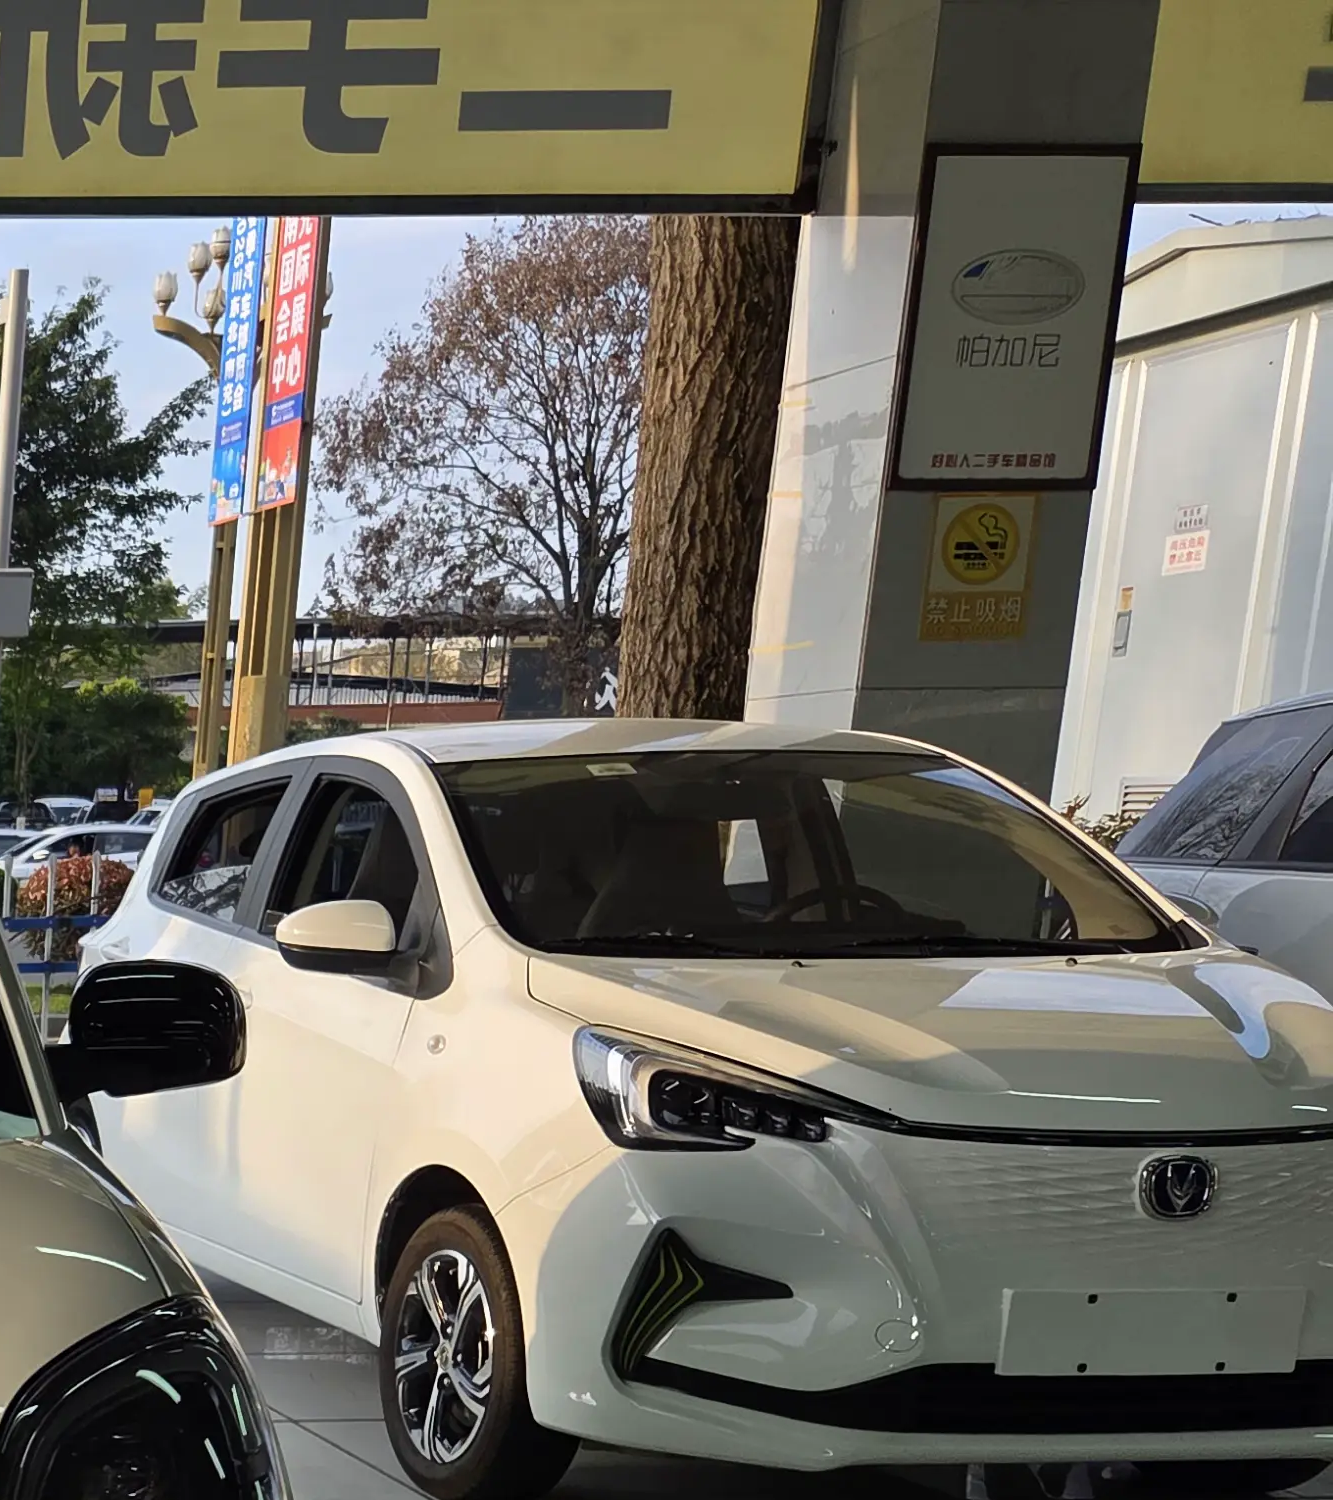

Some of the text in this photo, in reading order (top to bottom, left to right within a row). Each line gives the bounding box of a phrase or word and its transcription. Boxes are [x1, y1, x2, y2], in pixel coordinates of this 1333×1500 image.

[956, 333, 1062, 368] 帕加尼
[926, 595, 1022, 625] 禁止吸烟
